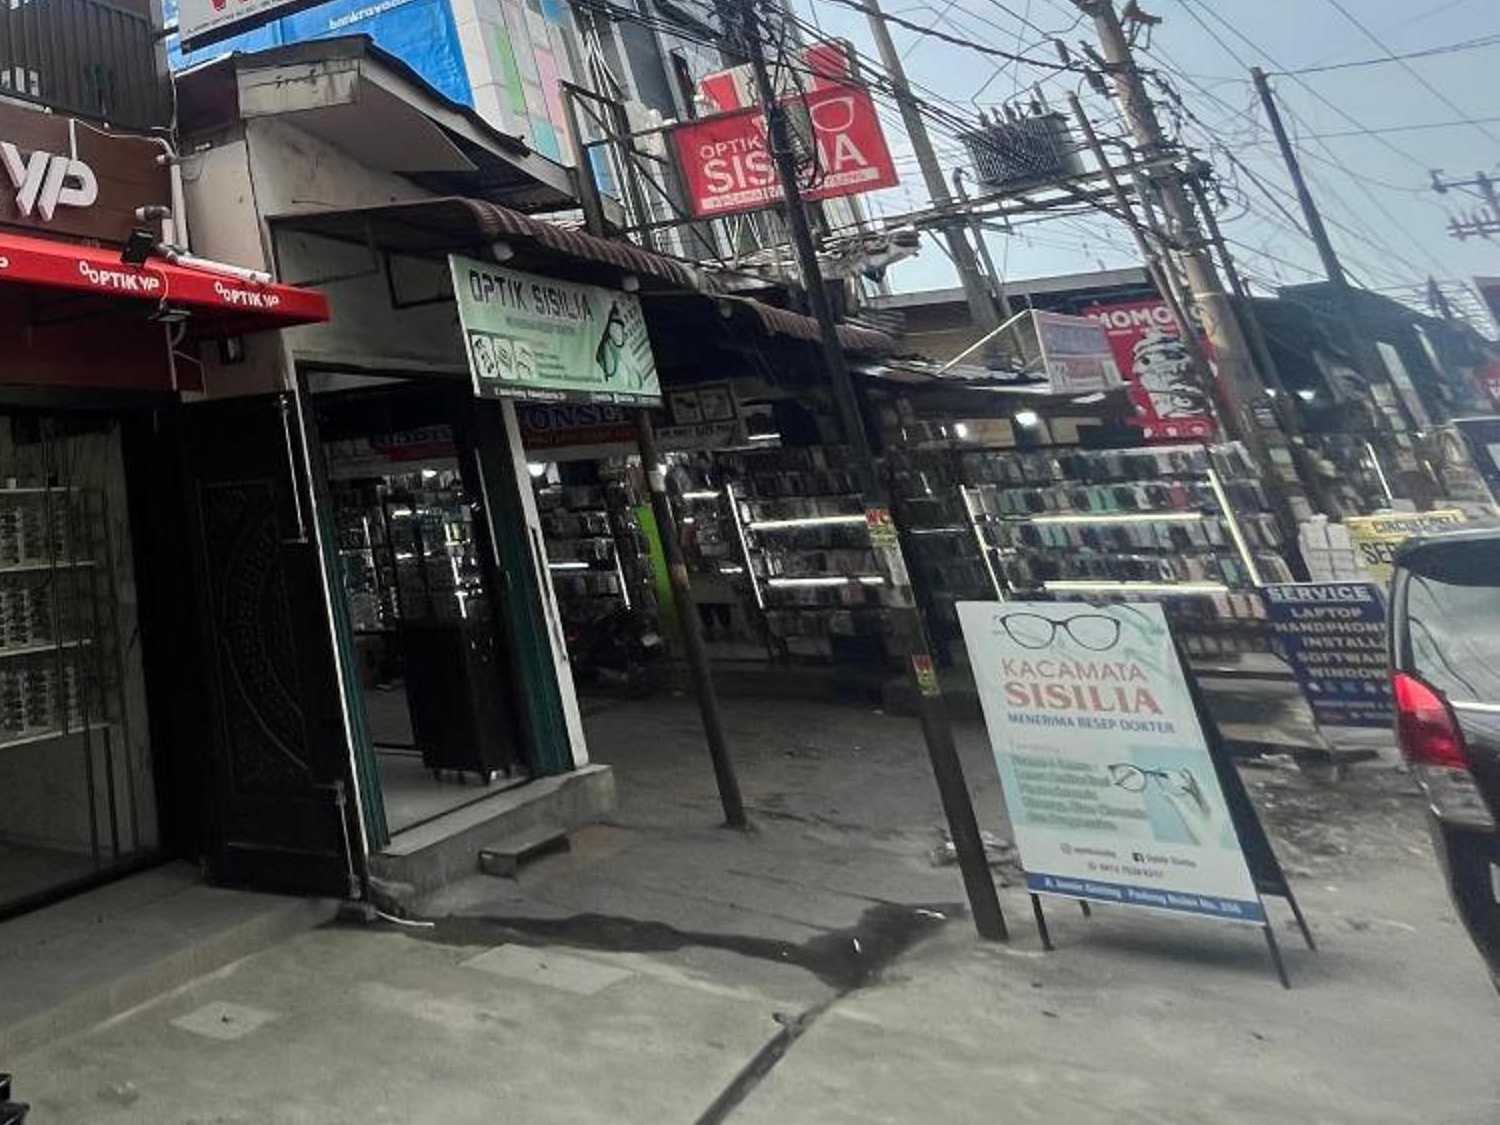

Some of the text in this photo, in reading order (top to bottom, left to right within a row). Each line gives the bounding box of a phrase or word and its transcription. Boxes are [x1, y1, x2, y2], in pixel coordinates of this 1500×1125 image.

[700, 136, 764, 161] OPTIK
[703, 133, 869, 194] SISIA
[469, 268, 596, 322] OPTIK SISILIA
[1361, 541, 1398, 565] SER
[1267, 585, 1373, 604] SERVICE
[1290, 607, 1363, 619] LAPTOP
[1001, 657, 1148, 683] KACAMATA
[1297, 652, 1388, 664] SOFTWAR
[1309, 667, 1389, 679] WINDOW
[1003, 681, 1164, 716] SISILIA
[1008, 712, 1176, 734] MENERIMA RESEP DOKTER
